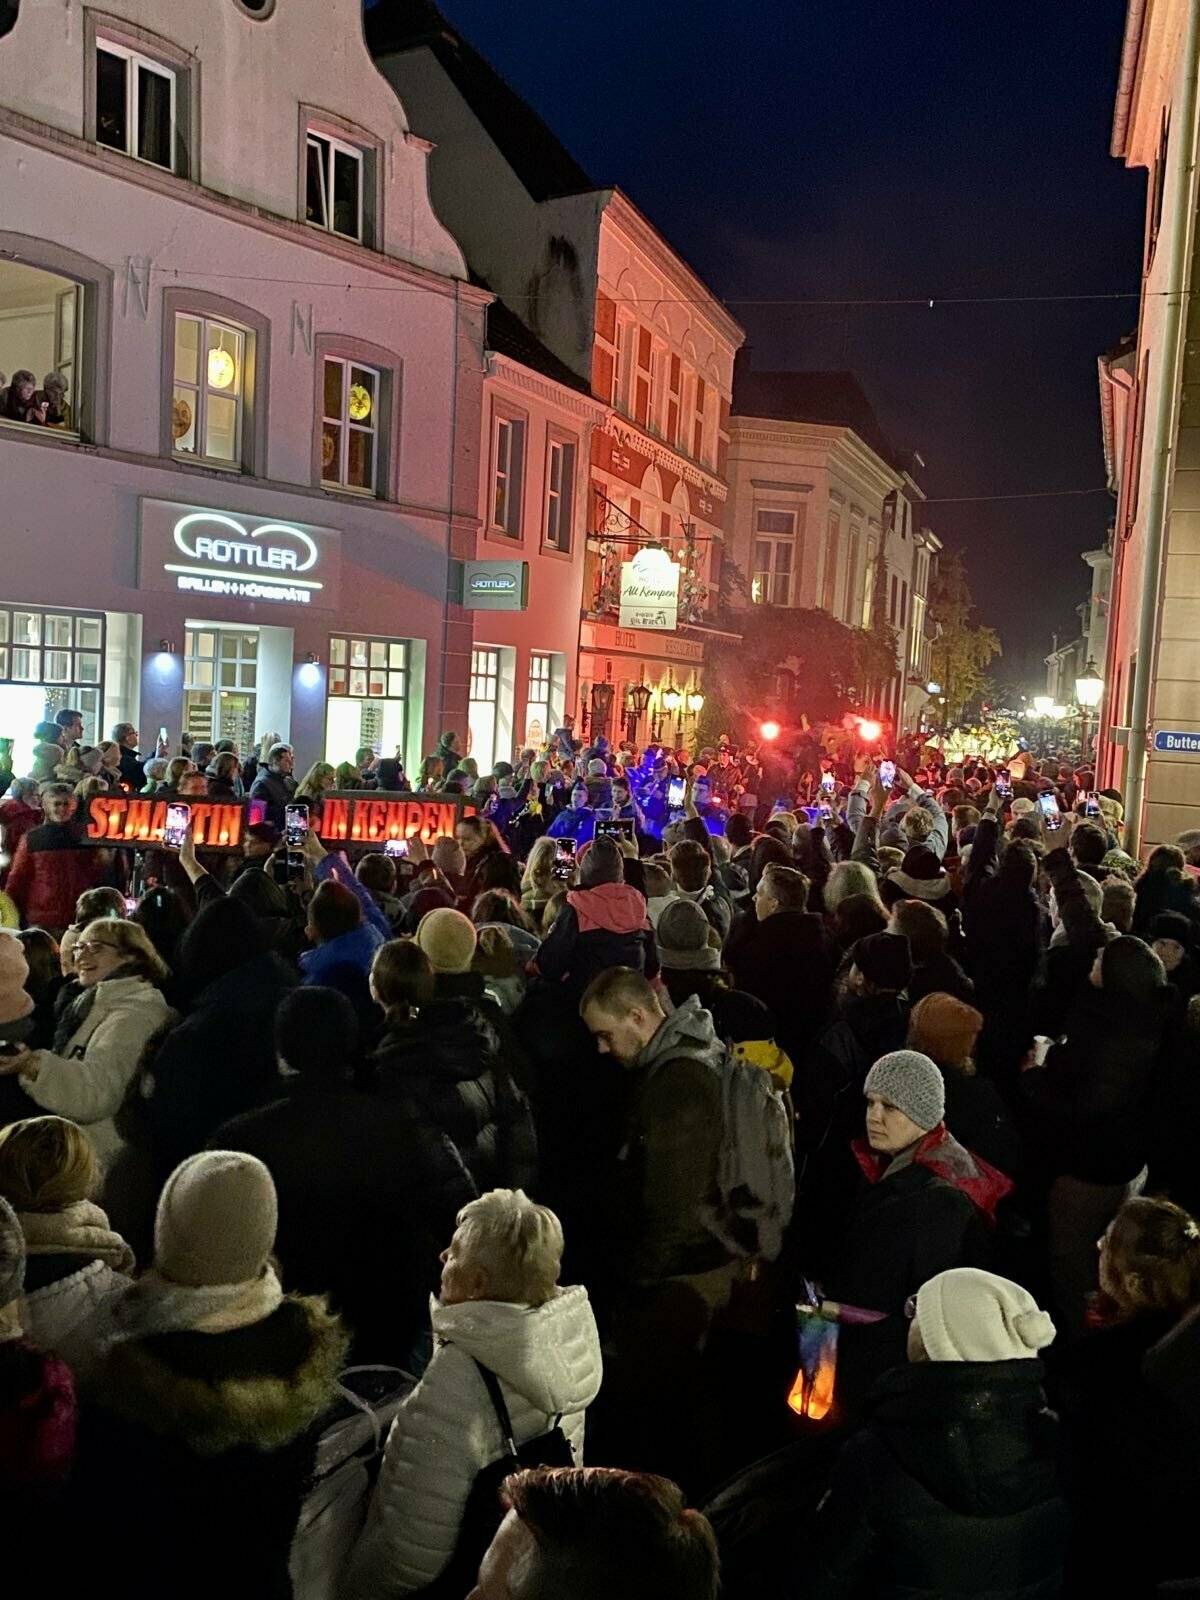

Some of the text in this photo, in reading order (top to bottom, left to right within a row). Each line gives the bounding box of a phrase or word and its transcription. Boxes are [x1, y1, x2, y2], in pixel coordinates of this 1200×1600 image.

[195, 537, 298, 571] ROTTLER
[639, 586, 676, 600] Kempen
[615, 630, 636, 649] HOTEL
